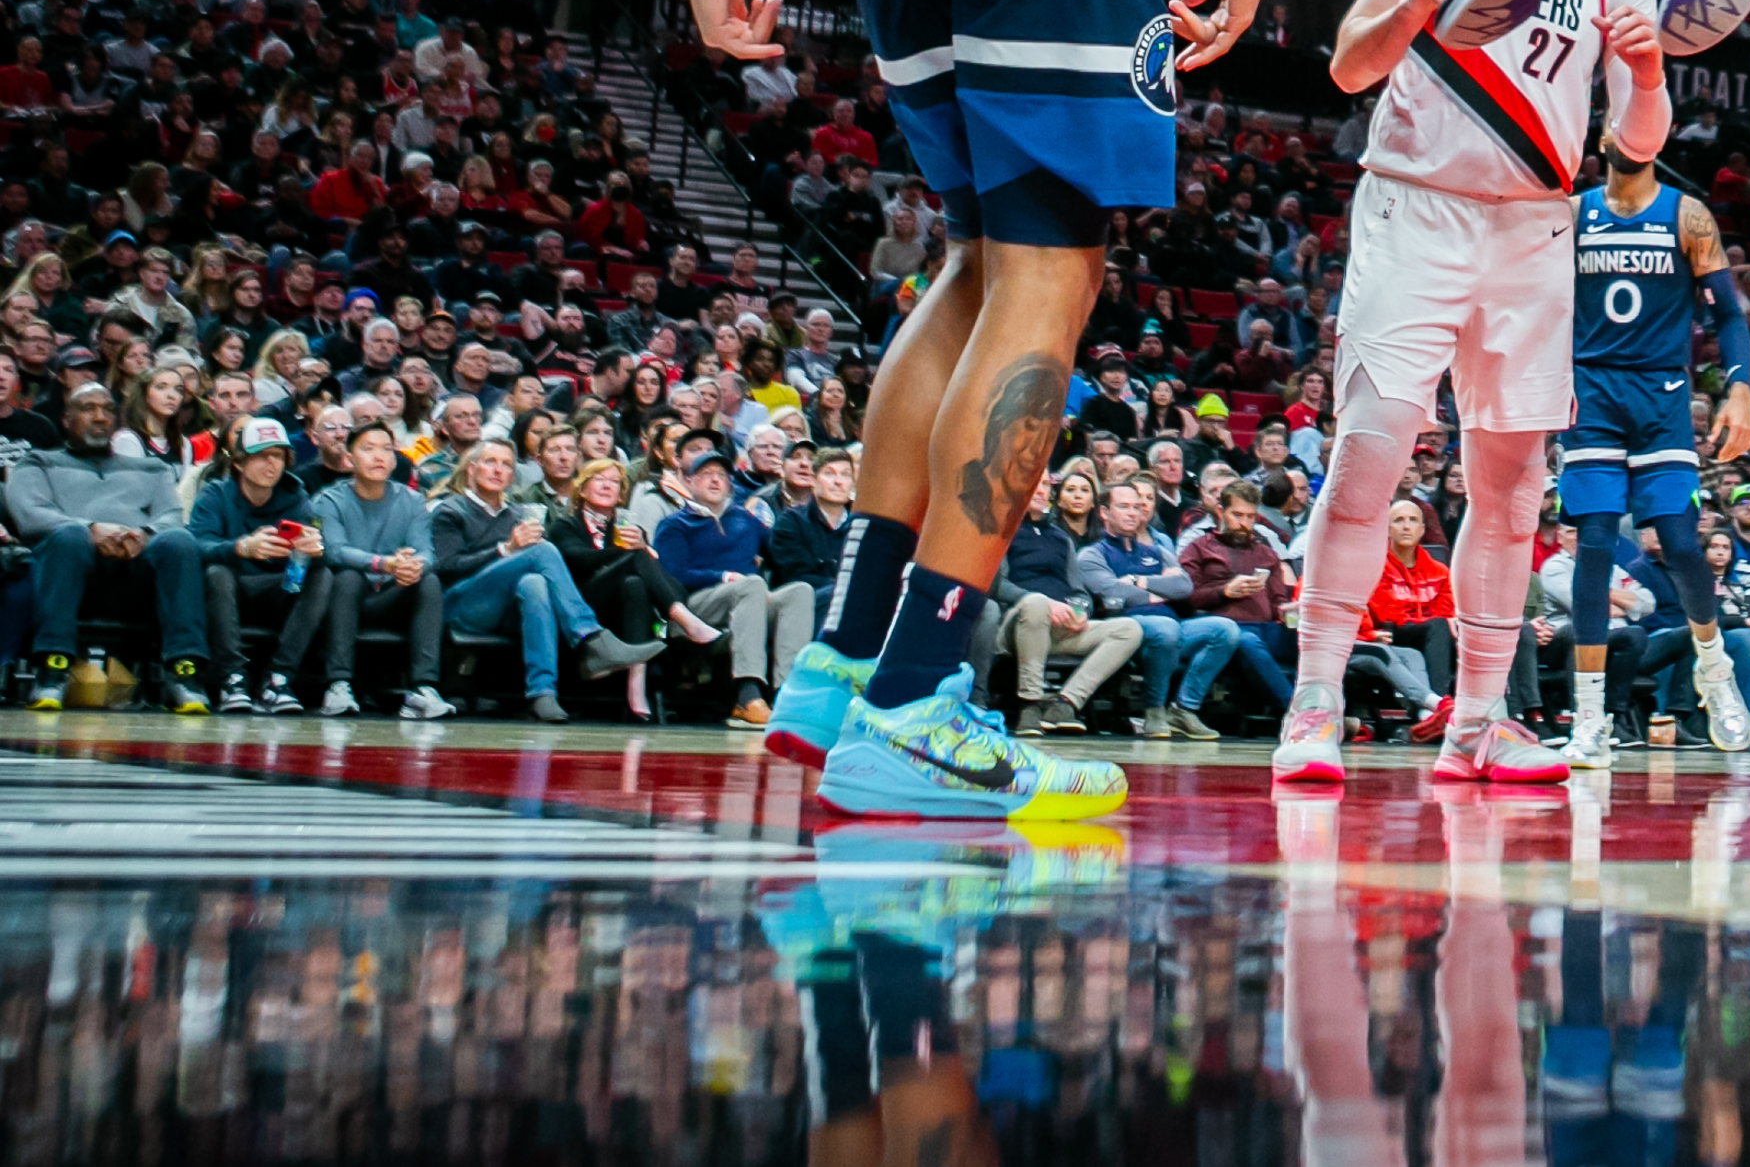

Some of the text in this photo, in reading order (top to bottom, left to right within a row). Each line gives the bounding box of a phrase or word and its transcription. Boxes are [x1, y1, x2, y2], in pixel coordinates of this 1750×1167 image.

[1135, 21, 1165, 82] MINNESOTA
[1521, 27, 1577, 85] 27
[1577, 249, 1675, 275] MINNESOTA
[1603, 279, 1643, 325] 0
